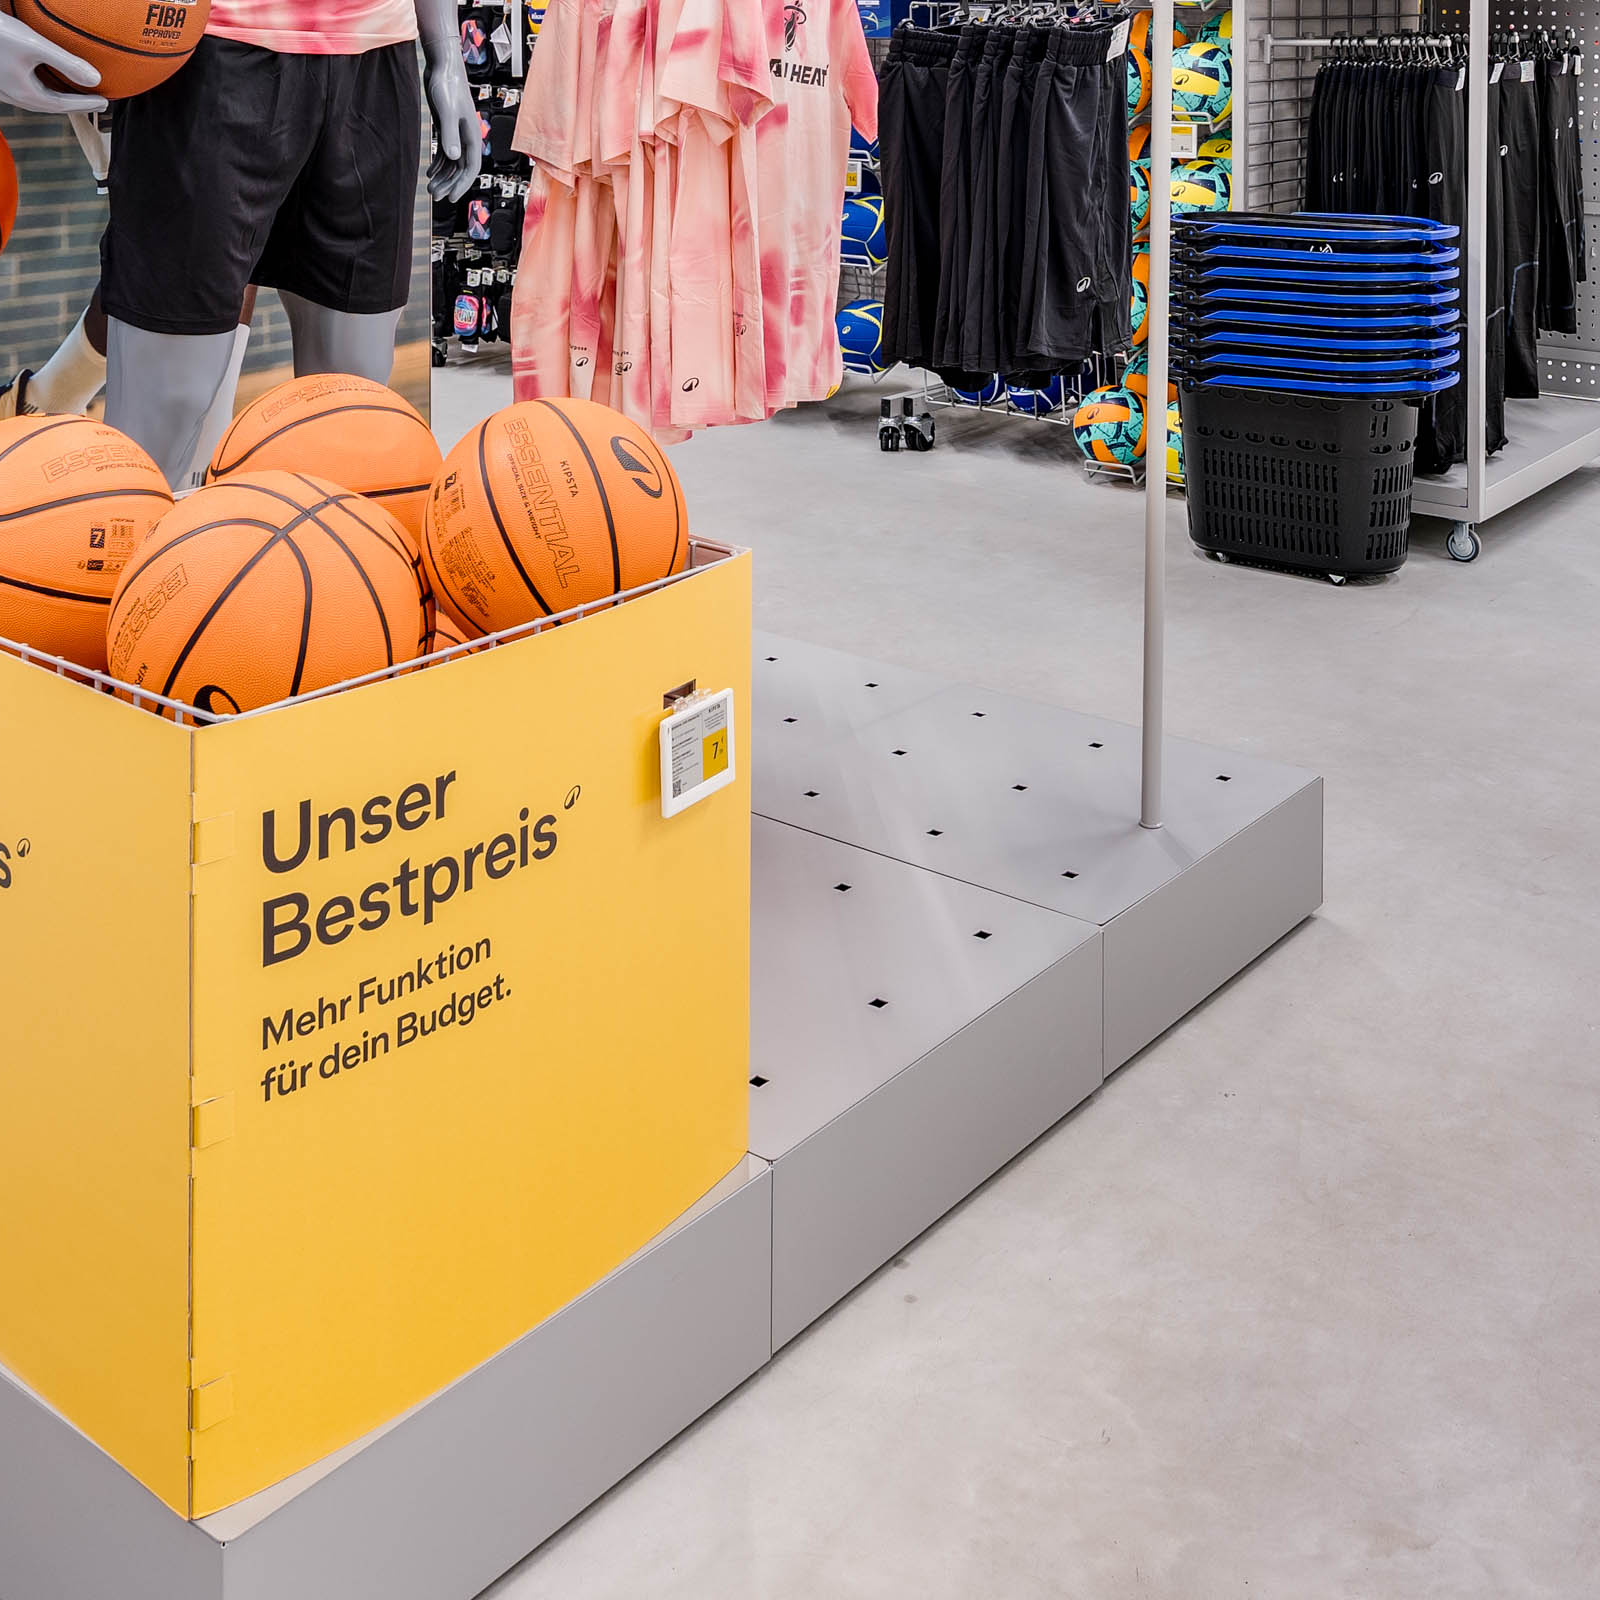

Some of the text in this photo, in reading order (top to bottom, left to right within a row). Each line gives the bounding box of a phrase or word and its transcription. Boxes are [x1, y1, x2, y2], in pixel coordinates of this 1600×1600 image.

[142, 28, 181, 40] APPROVED
[145, 4, 187, 28] FIBA
[790, 64, 829, 87] HEAT
[504, 416, 580, 589] ESSENTIAL
[559, 460, 579, 498] KIPSTA
[261, 769, 457, 875] Unser
[261, 806, 559, 968] Bestpreis
[260, 972, 512, 1103] für dein Budget.
[261, 936, 492, 1051] Mehr Funktion
